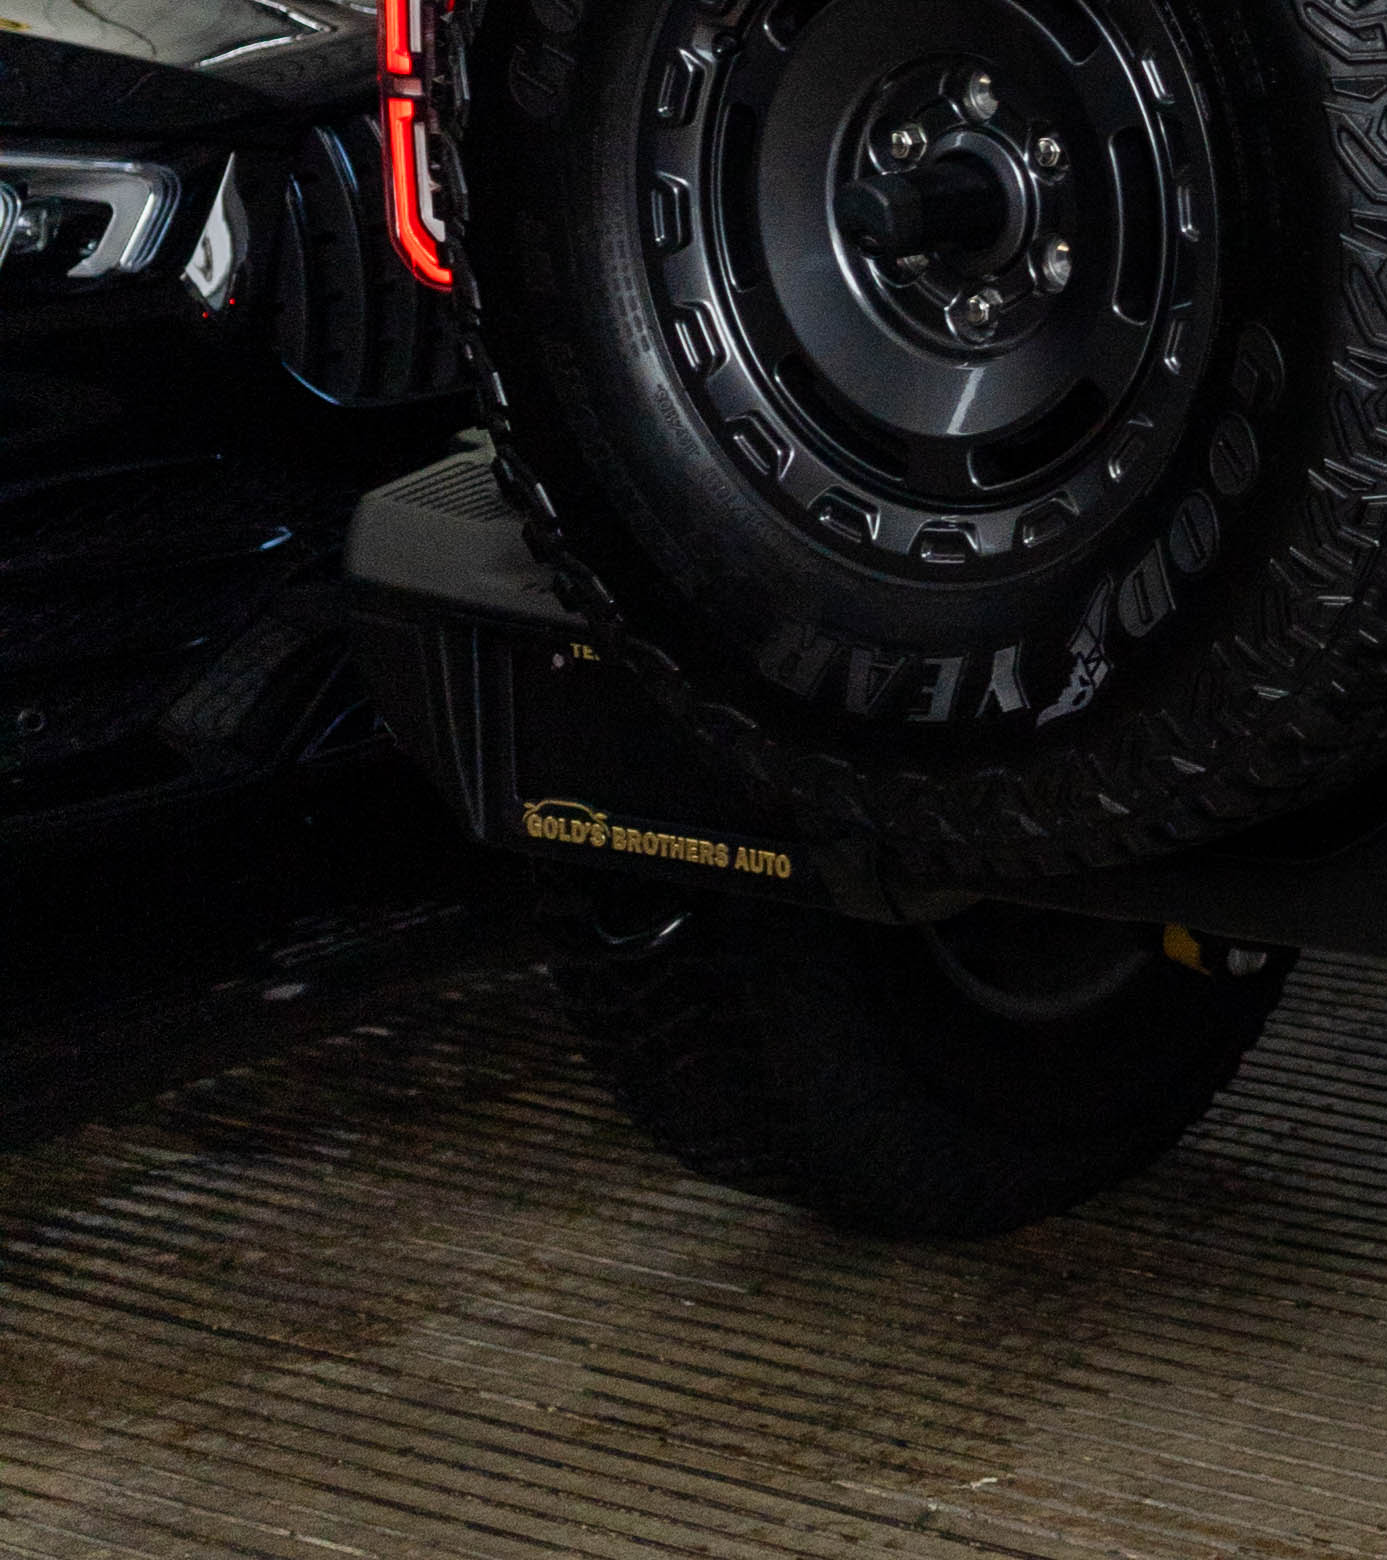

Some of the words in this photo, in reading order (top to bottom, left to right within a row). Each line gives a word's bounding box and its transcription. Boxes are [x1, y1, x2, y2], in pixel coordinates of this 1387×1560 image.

[526, 813, 607, 847] GOLD'S
[611, 825, 729, 868] BROTHERS
[735, 846, 792, 879] AUTO
